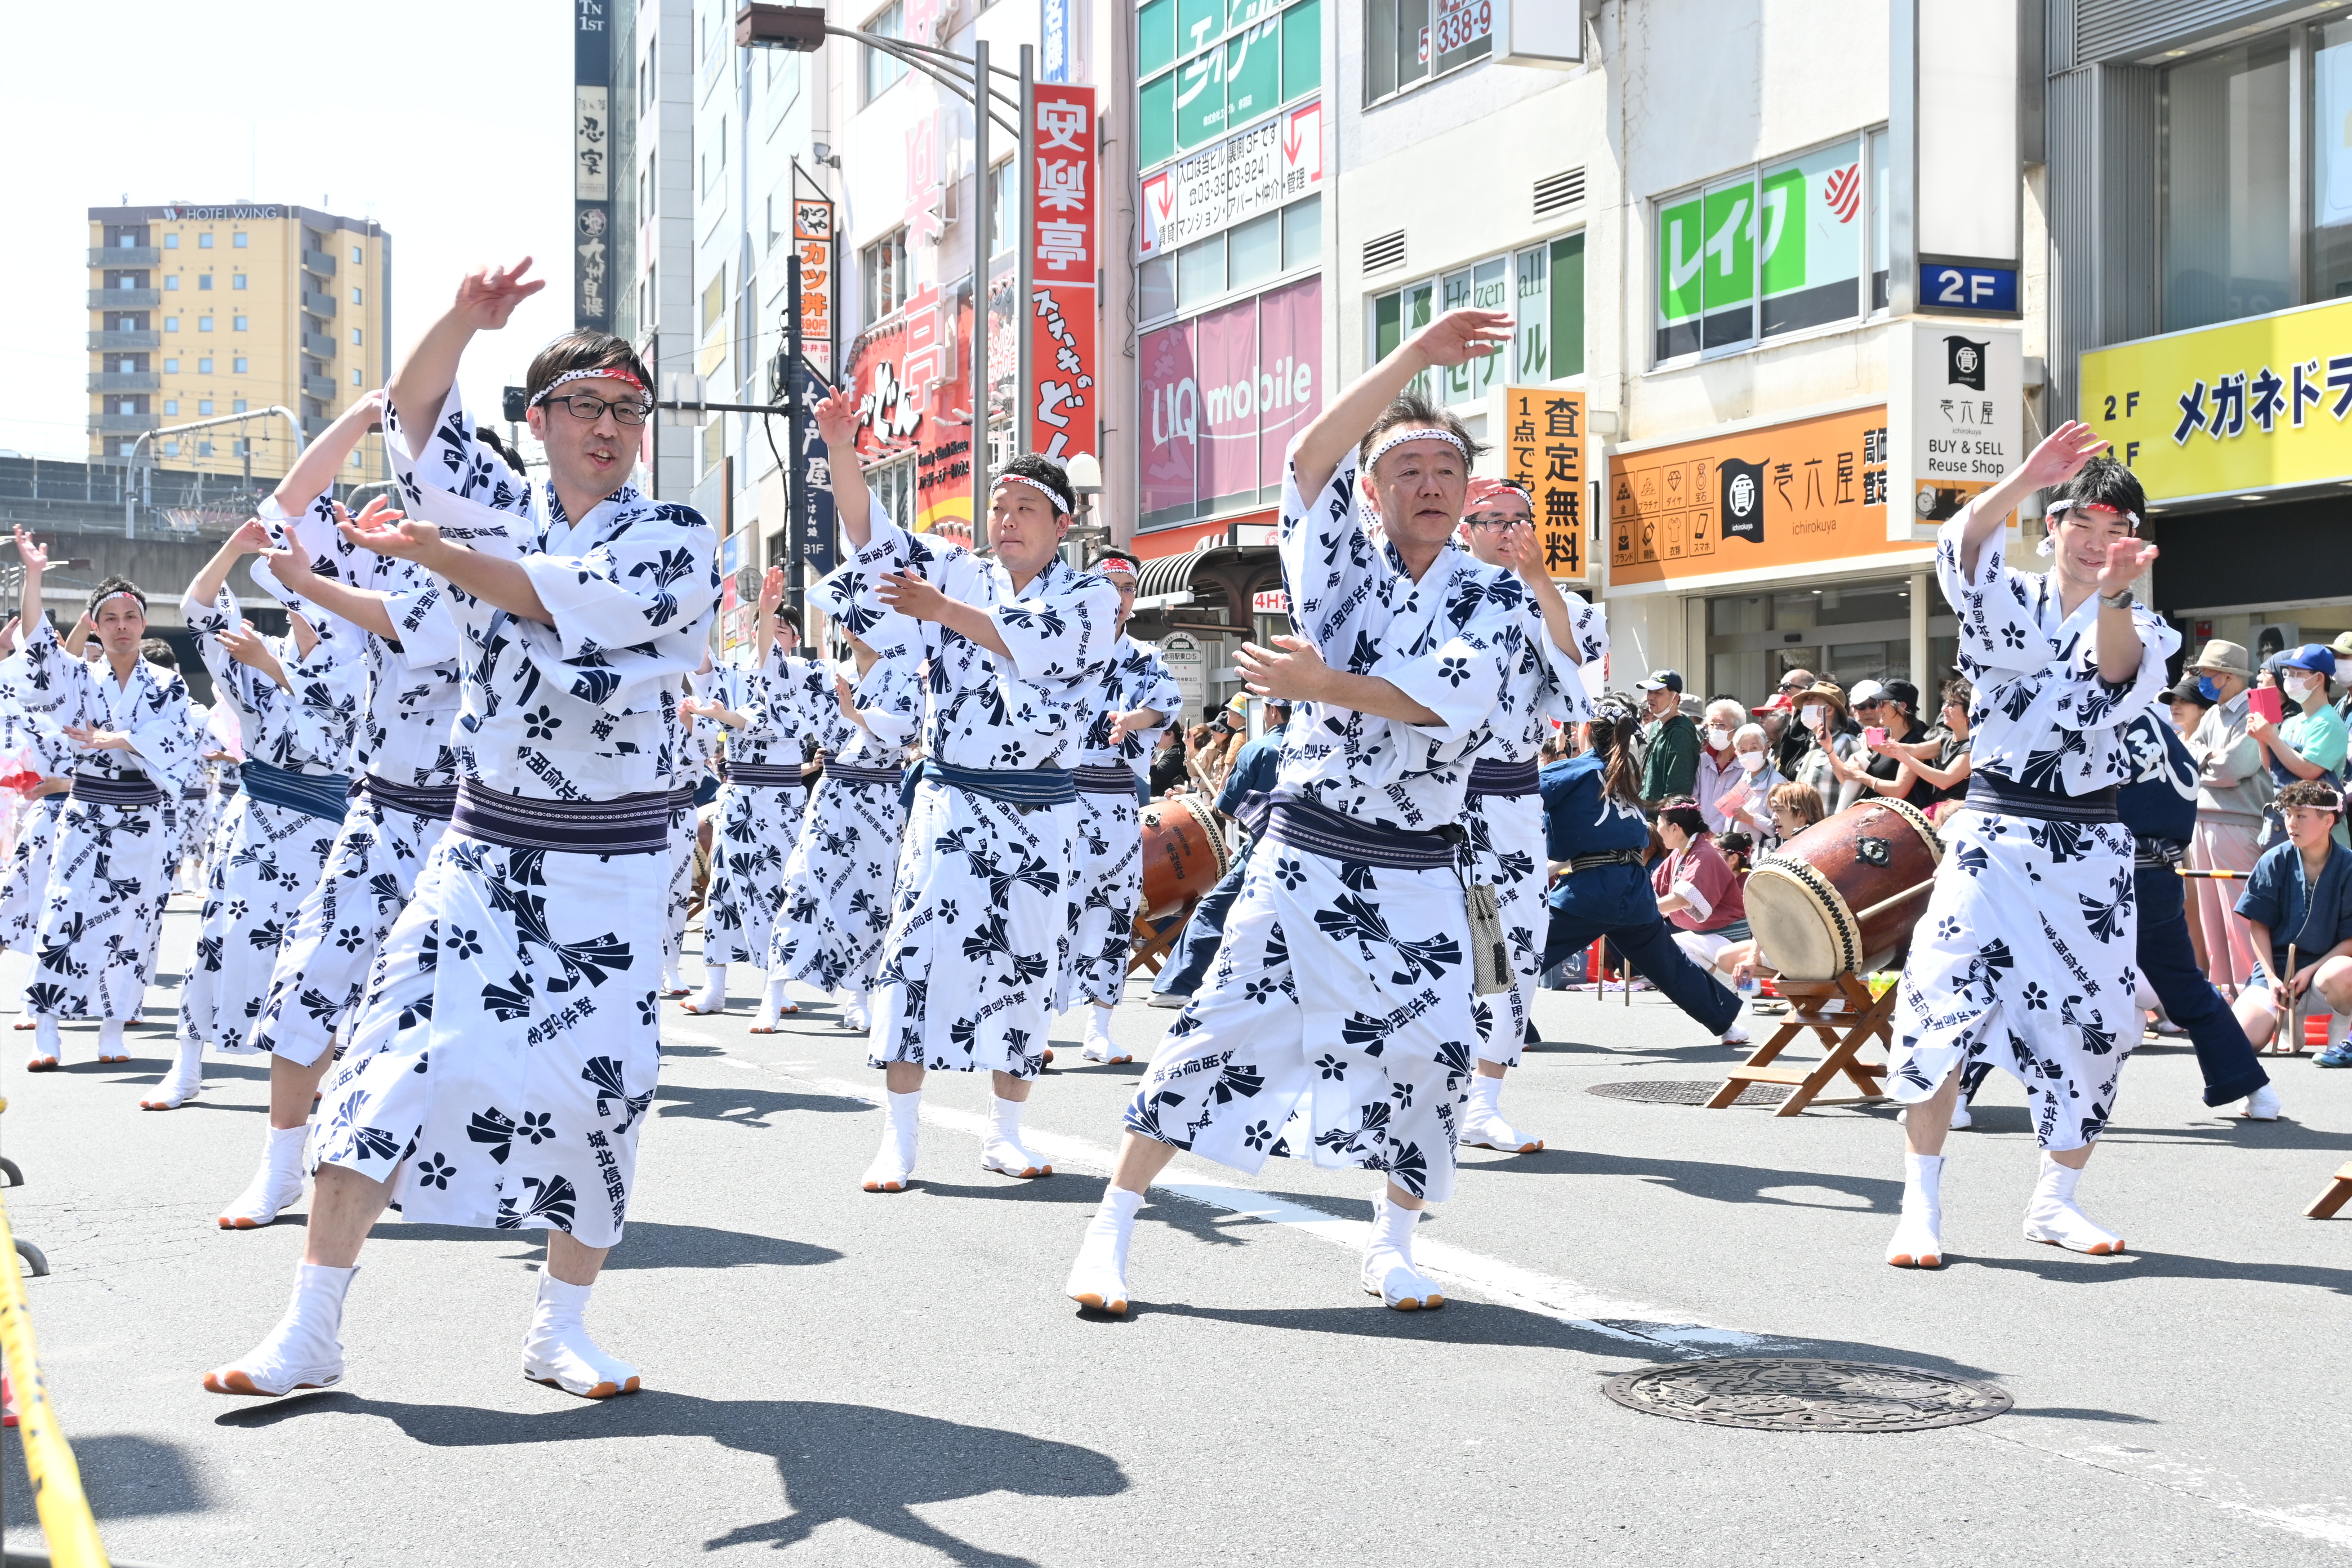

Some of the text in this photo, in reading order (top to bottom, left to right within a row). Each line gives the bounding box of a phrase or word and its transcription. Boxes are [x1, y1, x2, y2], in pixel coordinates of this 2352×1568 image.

[1203, 103, 1235, 127] 株式会社エブル
[1037, 99, 1086, 270] 安楽亭
[186, 207, 229, 221] HOTEL
[233, 207, 277, 220] WING
[1669, 186, 1787, 292] レイク
[578, 238, 606, 318] 九州自慢
[801, 242, 827, 317] カツ丼
[1938, 270, 1995, 305] 2F
[1032, 289, 1093, 389] ステーキの
[1153, 377, 1200, 445] UQ
[1208, 356, 1311, 426] mobile
[1940, 399, 1994, 425] 壱六屋
[1953, 427, 1981, 436] ichirokuya
[1929, 439, 2004, 456] BUY & SELL
[1929, 458, 2004, 478] Reuse Shop
[1544, 398, 1579, 572] 査定無料
[1774, 452, 1855, 512] 壱六屋
[1667, 496, 1682, 506] ダイヤ
[1695, 492, 1707, 502] 宝石
[1732, 523, 1753, 531] ichirokuya
[1793, 519, 1836, 535] ichirokuya
[1615, 552, 1633, 563] ブランド
[1643, 549, 1655, 559] 時計
[1669, 545, 1681, 556] 衣類
[1694, 542, 1710, 551] スマホ
[853, 802, 894, 845] 城北信用金庫
